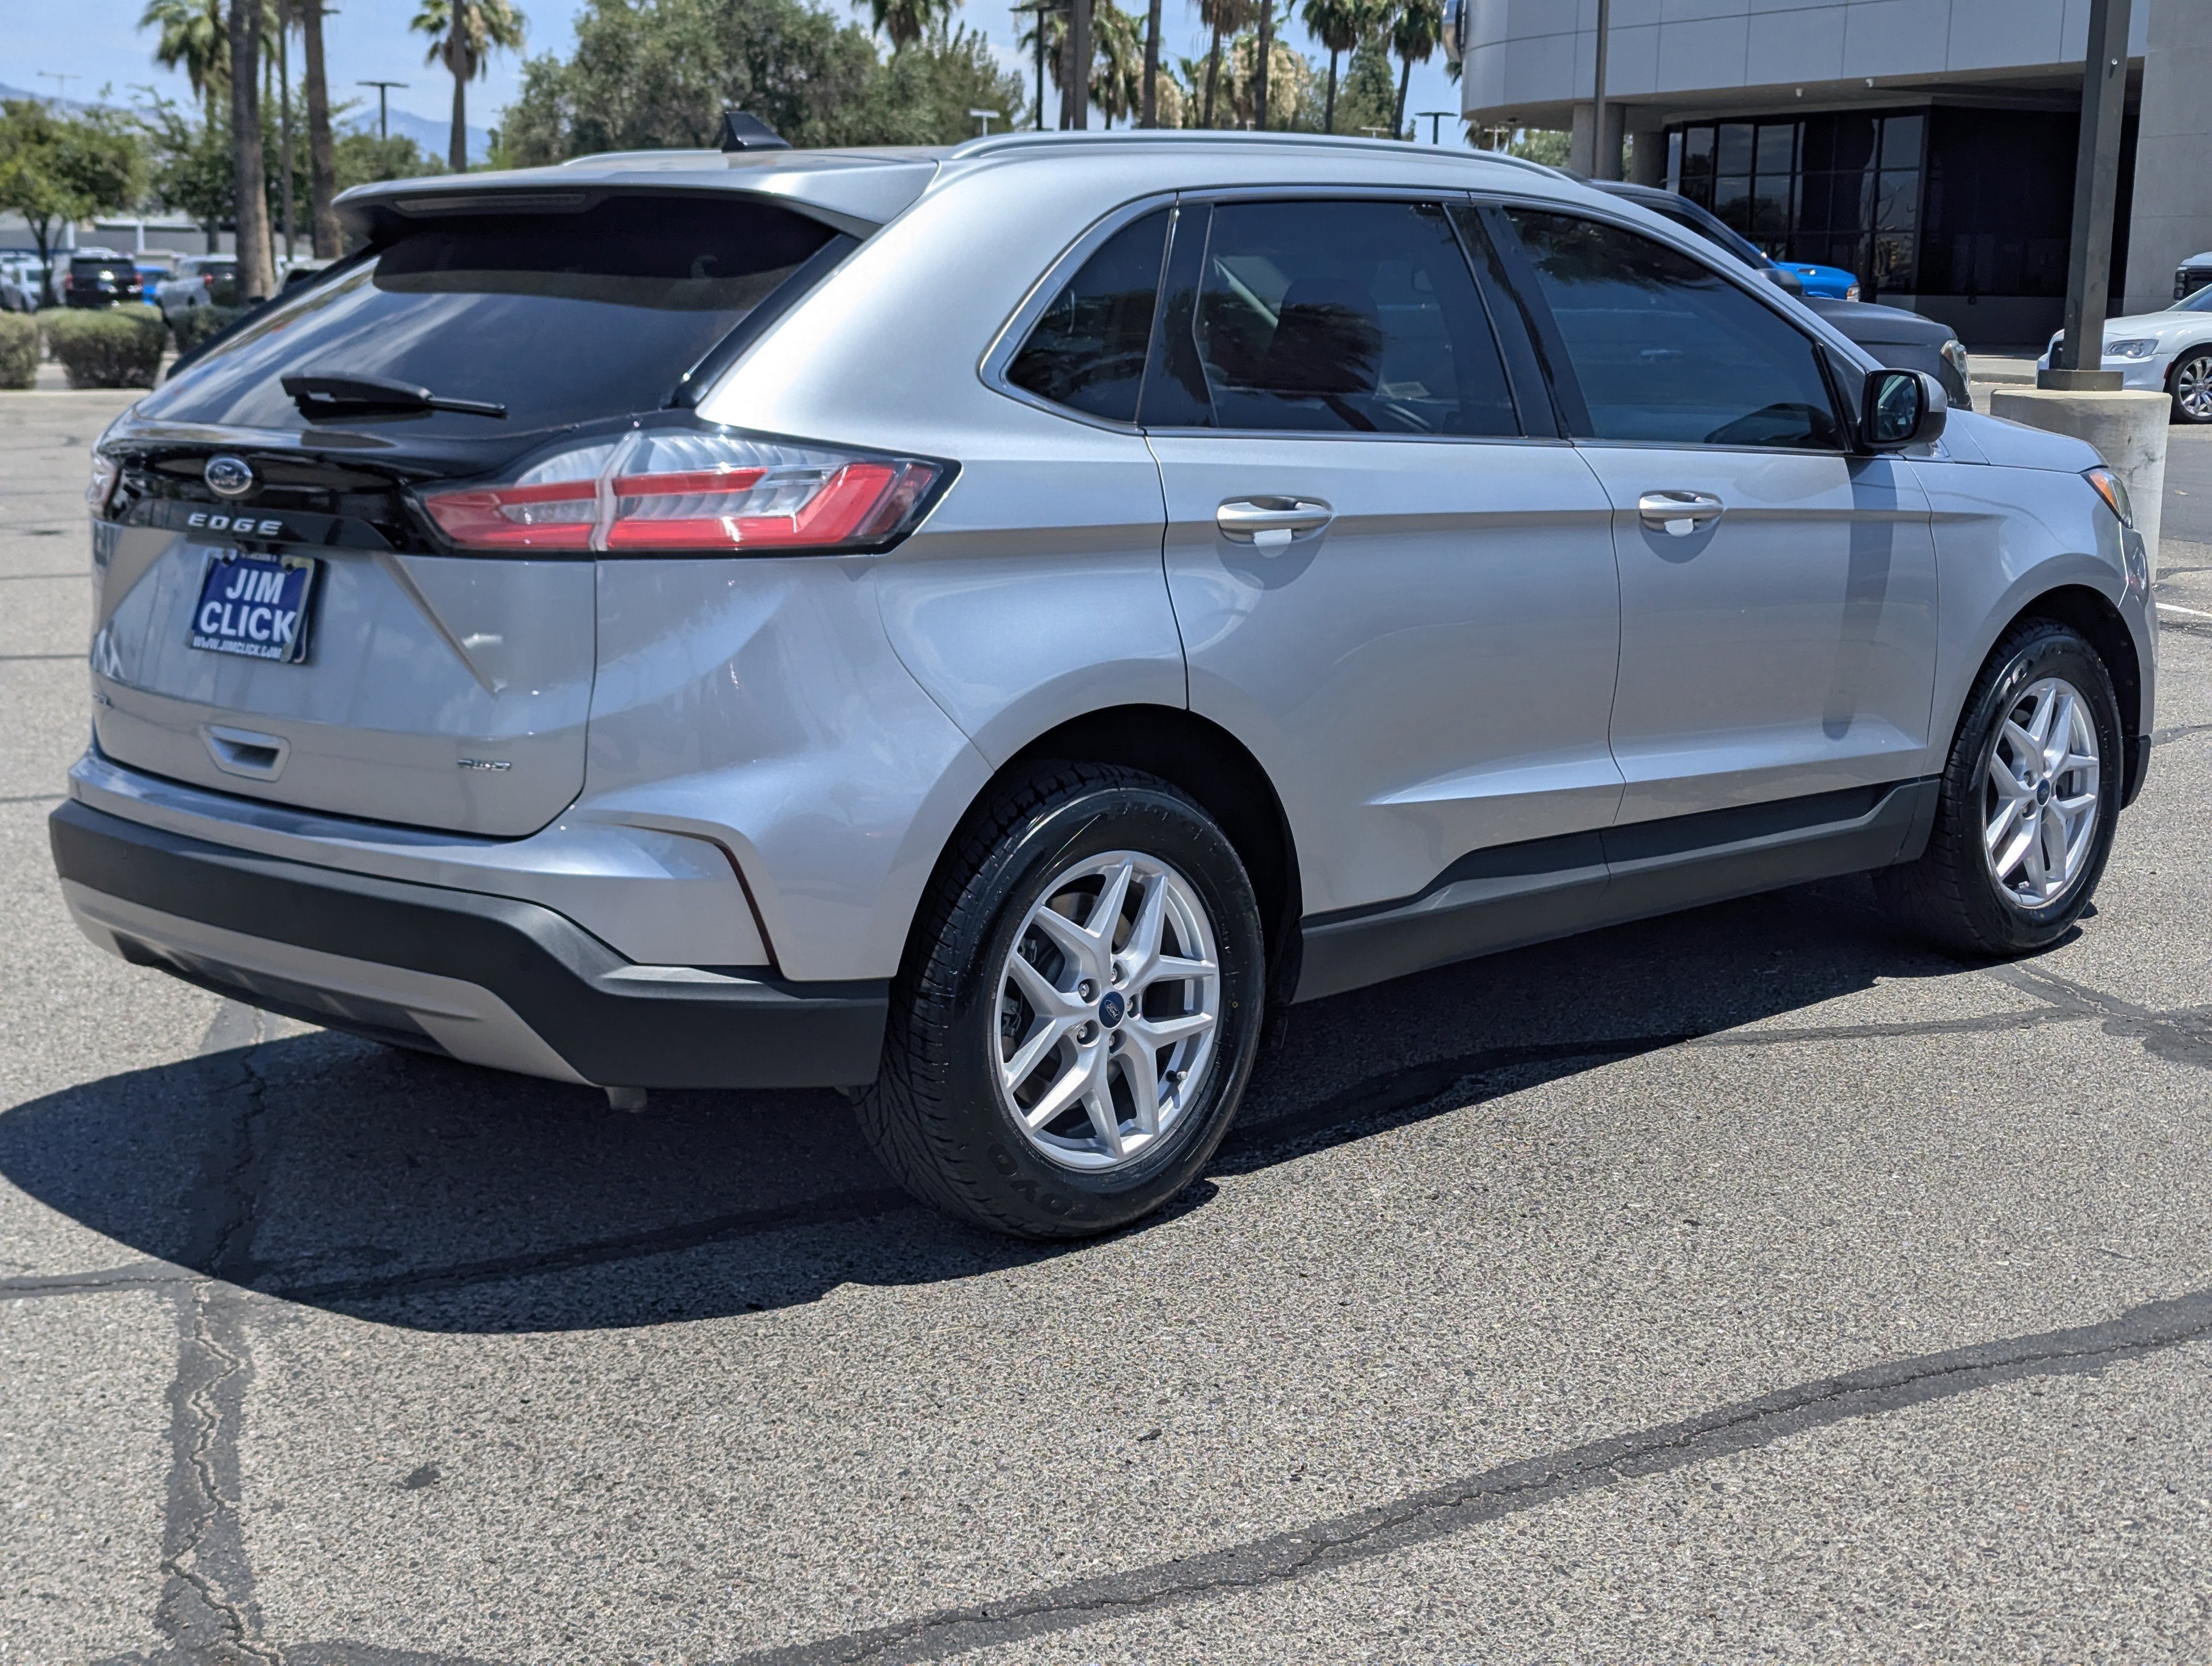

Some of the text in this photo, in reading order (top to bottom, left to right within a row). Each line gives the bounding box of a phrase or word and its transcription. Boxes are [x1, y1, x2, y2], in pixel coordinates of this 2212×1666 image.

[188, 512, 282, 535] EDGE
[226, 568, 285, 604] JIM
[200, 601, 297, 644] CLICK
